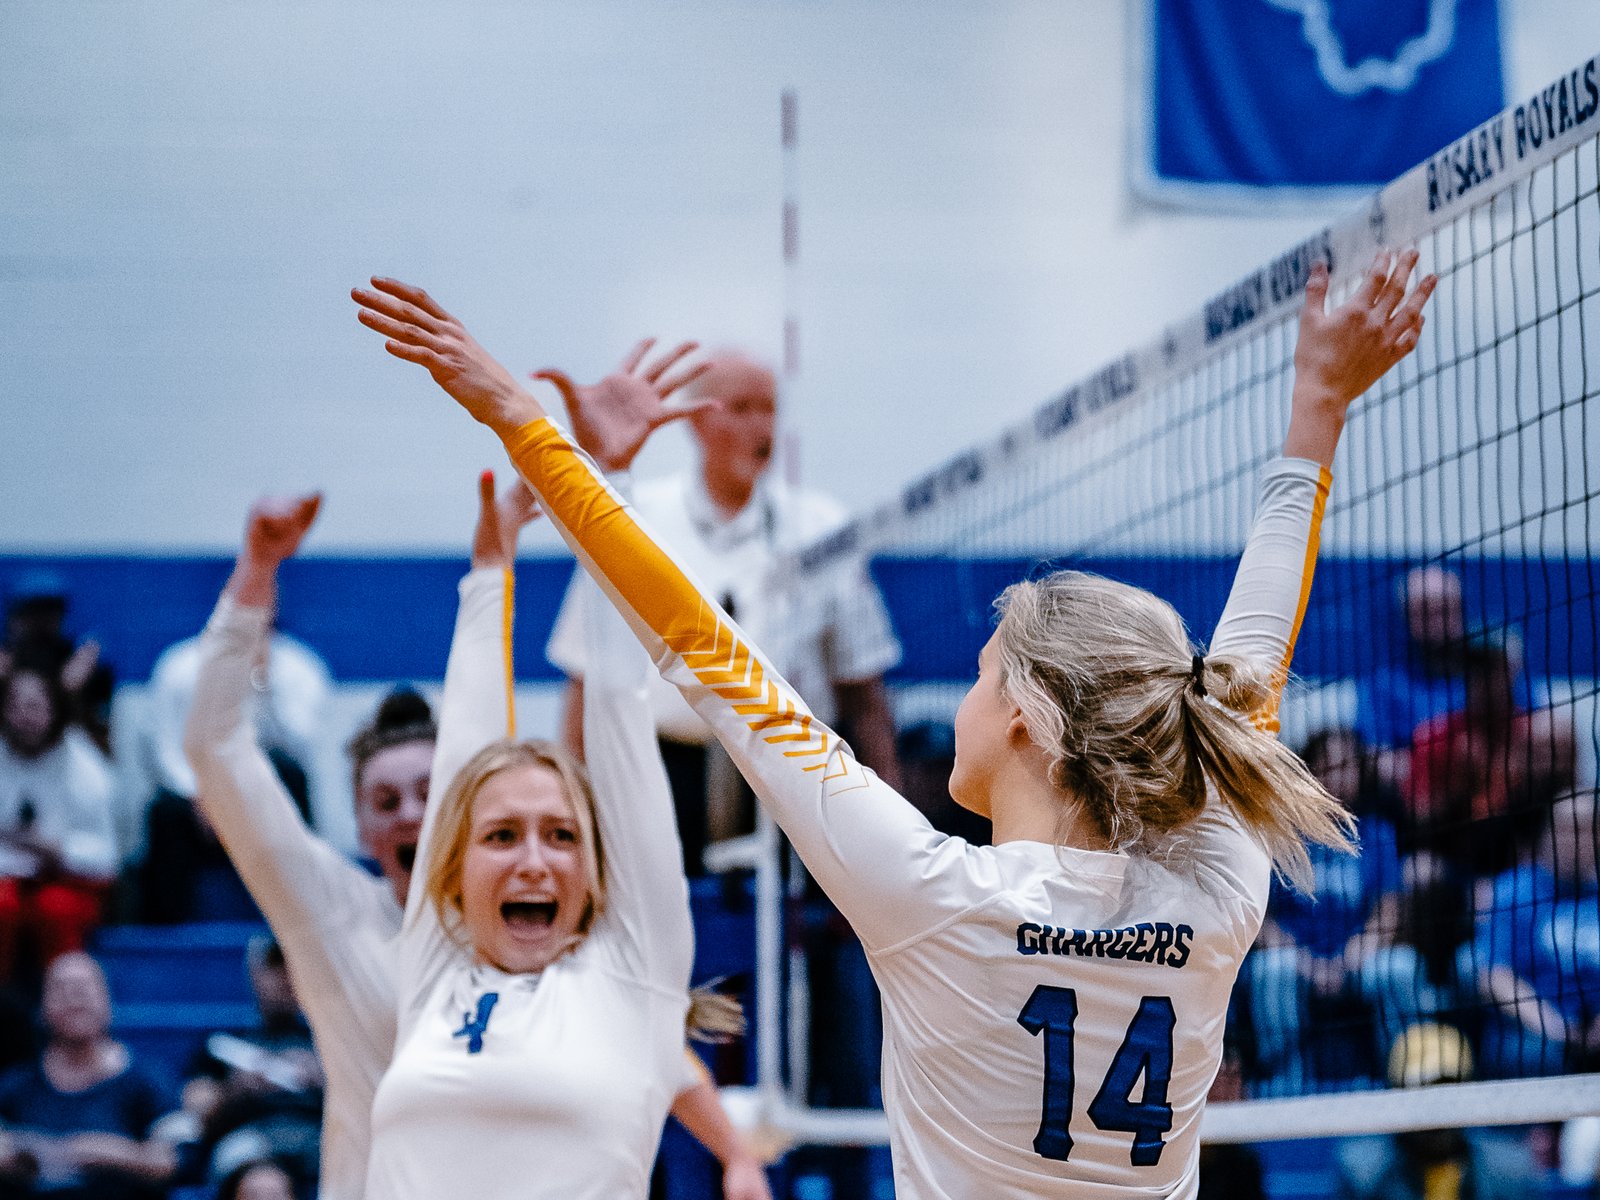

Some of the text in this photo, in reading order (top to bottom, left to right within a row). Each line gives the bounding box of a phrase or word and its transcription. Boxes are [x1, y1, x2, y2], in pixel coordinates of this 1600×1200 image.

[1513, 58, 1599, 161] ROYALS
[1016, 922, 1194, 968] CHARGERS
[1016, 984, 1178, 1166] 14
